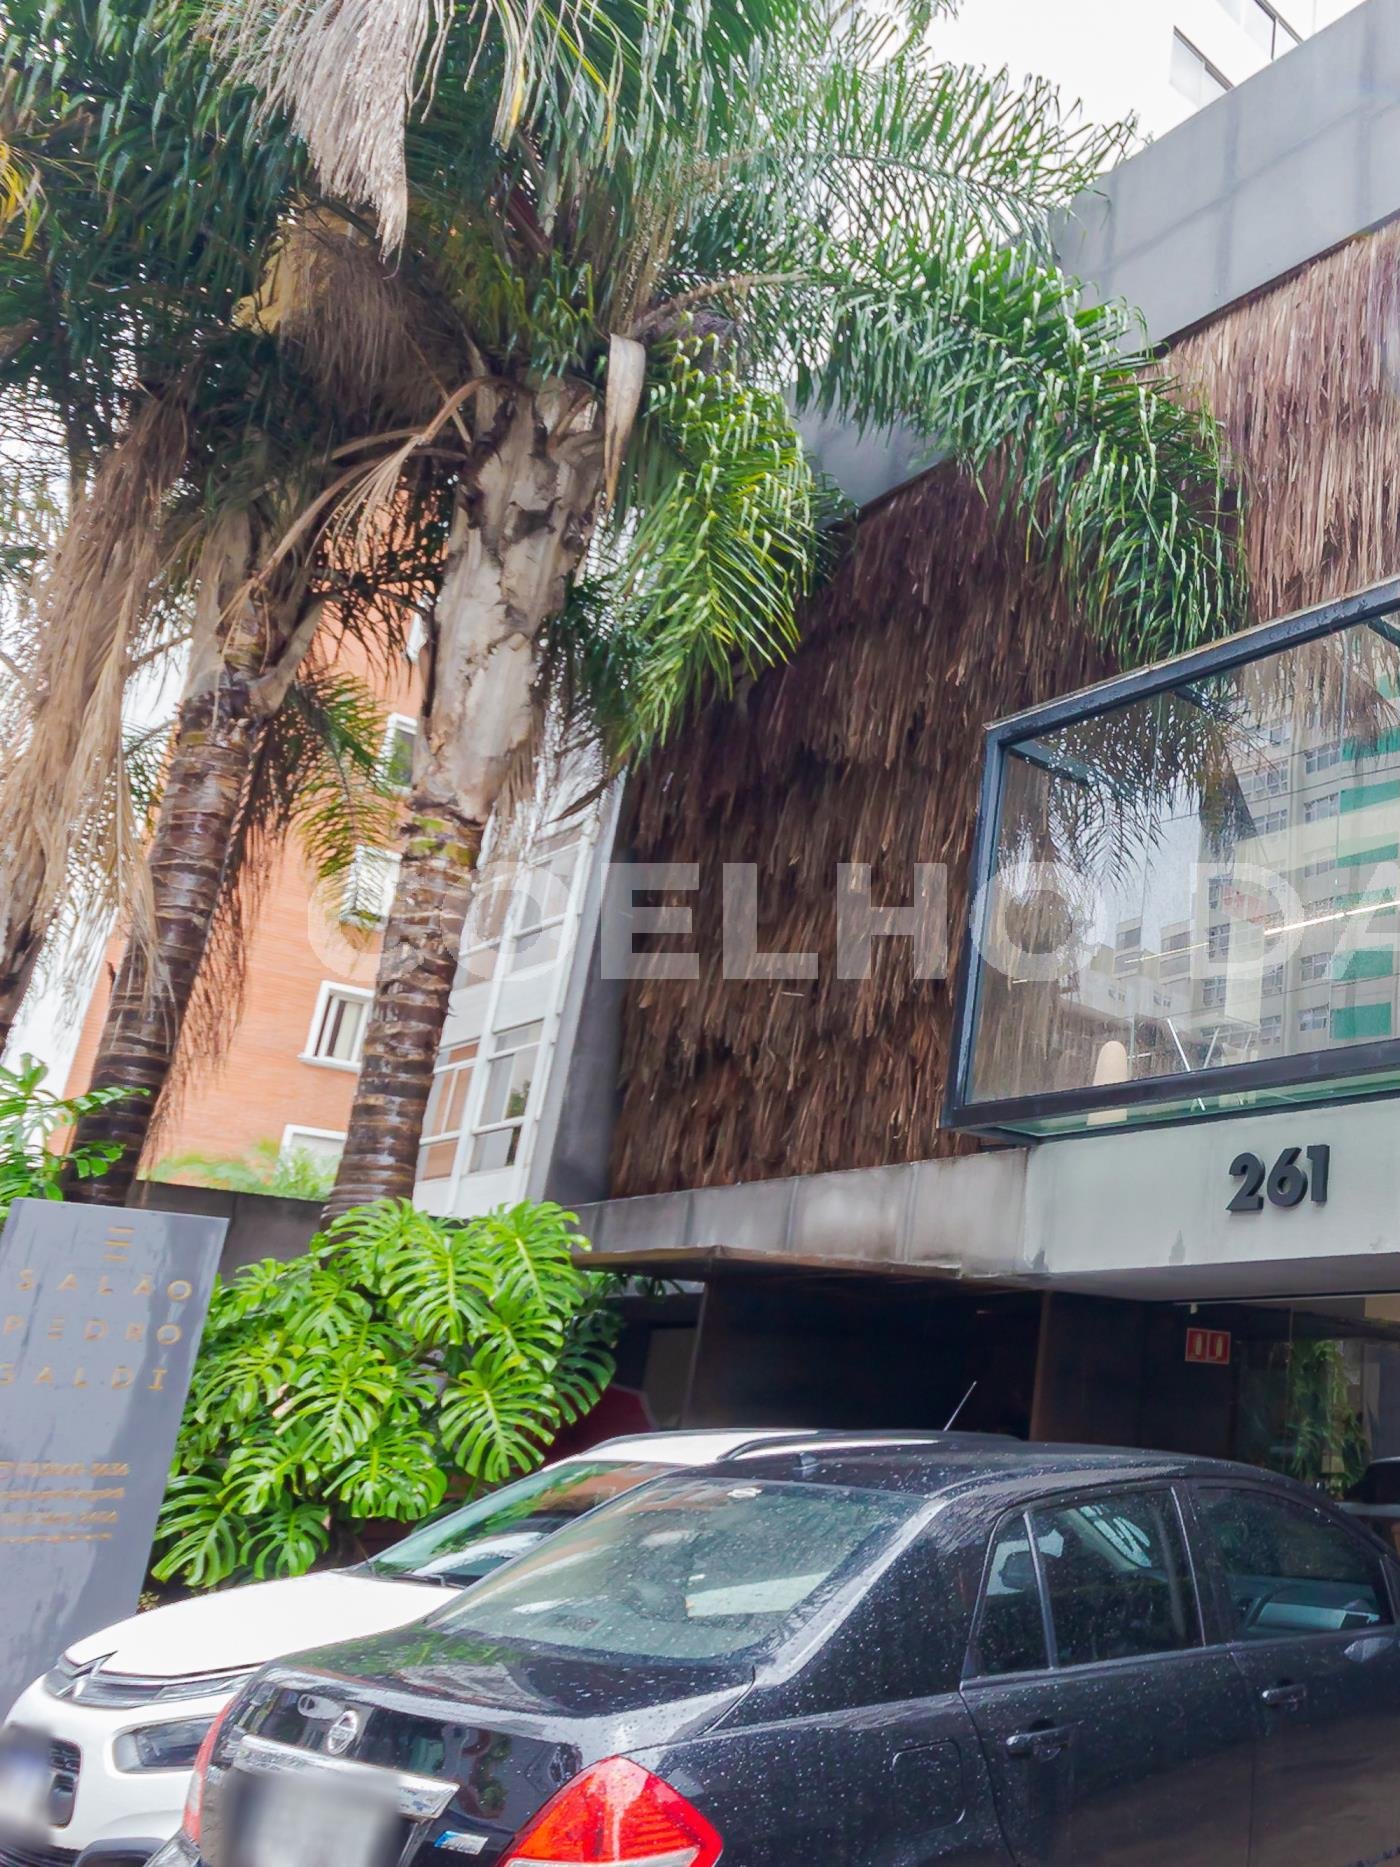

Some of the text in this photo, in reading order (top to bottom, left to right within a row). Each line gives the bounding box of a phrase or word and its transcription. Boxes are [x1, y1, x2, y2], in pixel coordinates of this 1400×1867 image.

[1226, 1144, 1330, 1211] 261
[17, 1268, 193, 1302] SALÃO
[3, 1315, 182, 1345] PEDRO
